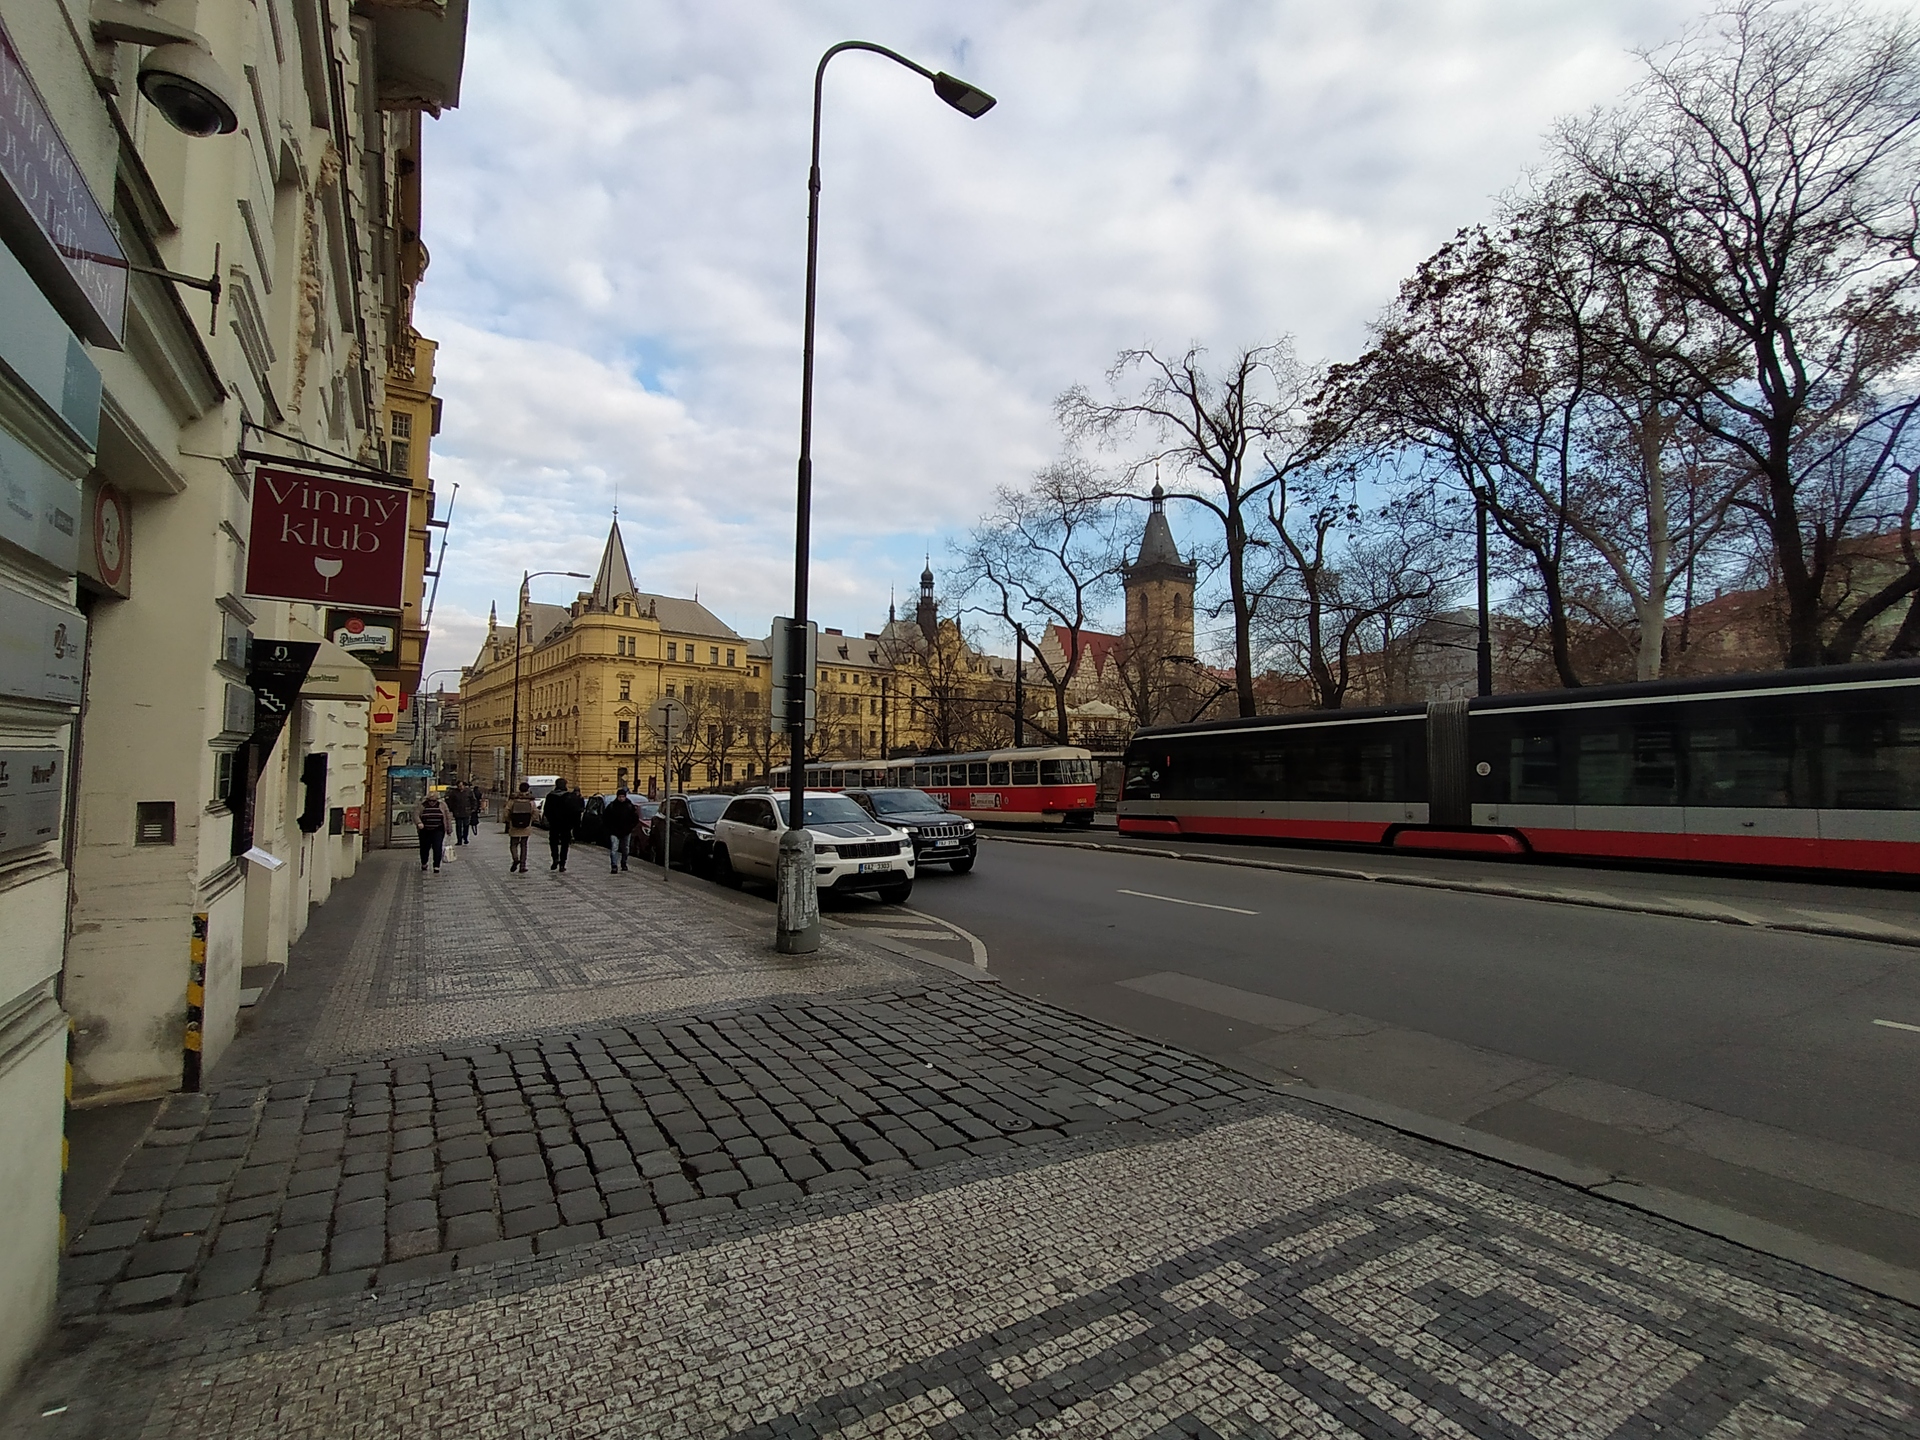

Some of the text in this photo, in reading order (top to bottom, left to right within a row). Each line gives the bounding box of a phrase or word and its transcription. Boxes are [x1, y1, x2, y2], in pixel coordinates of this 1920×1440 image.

[2, 47, 88, 230] Vinotéka
[263, 476, 400, 526] Vinný
[280, 513, 380, 553] klub
[339, 633, 387, 647] Pilsner Urquell
